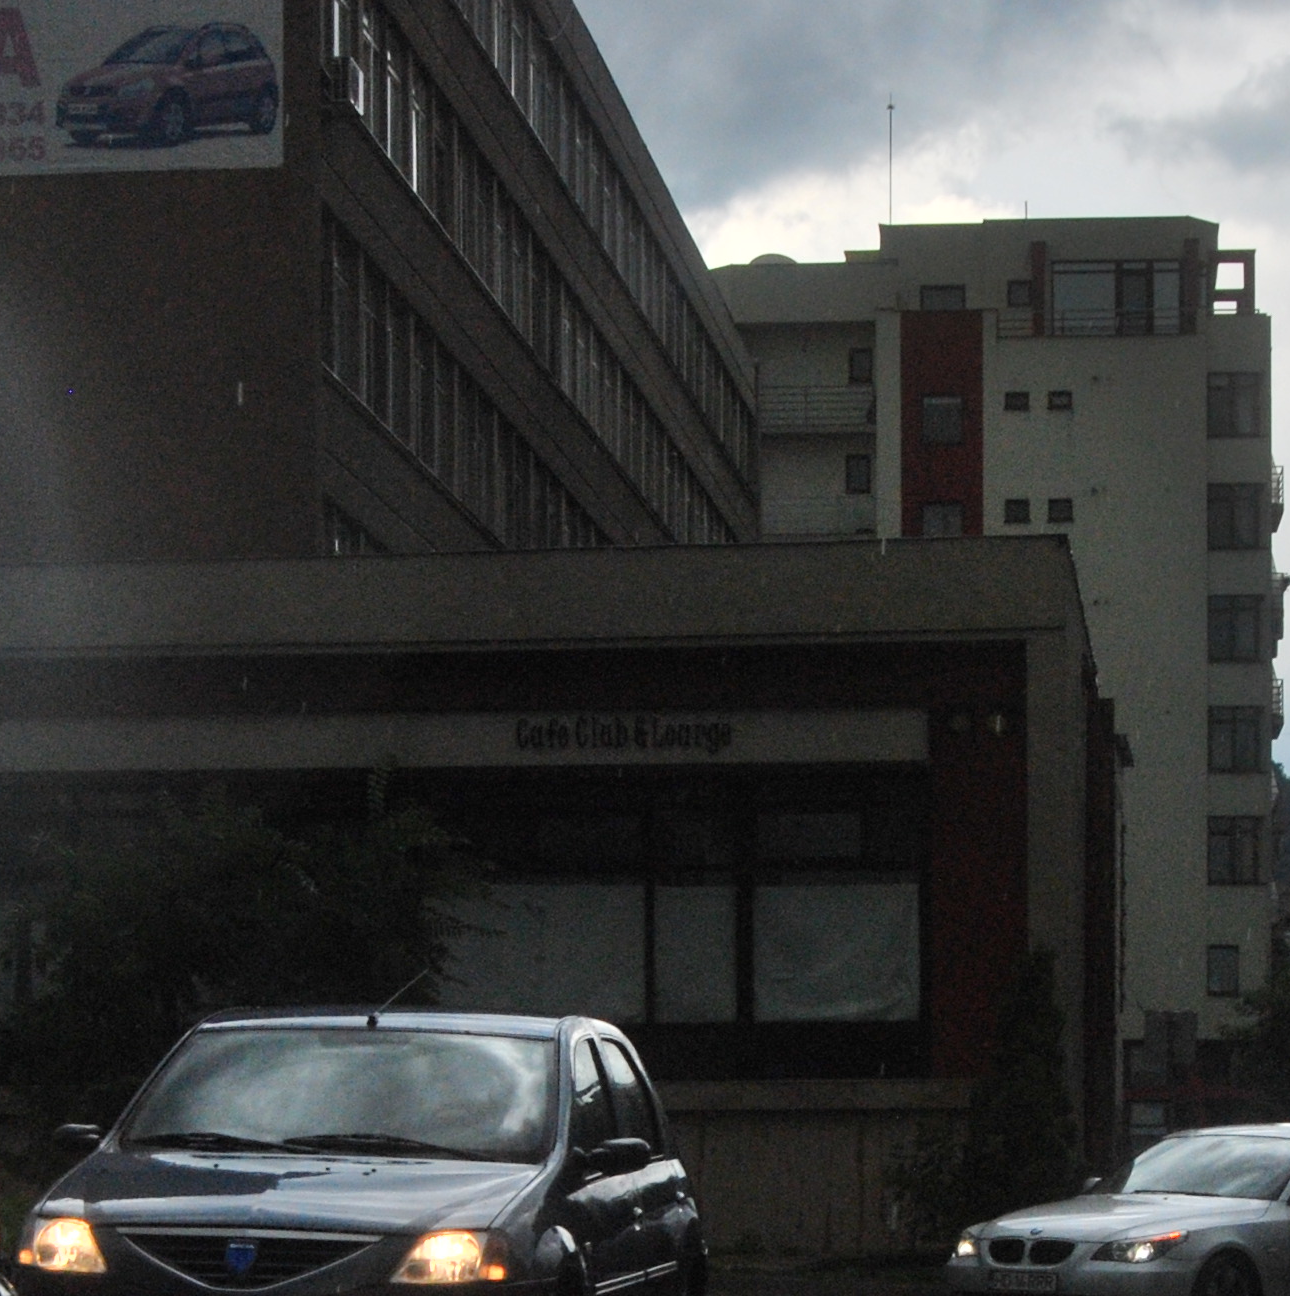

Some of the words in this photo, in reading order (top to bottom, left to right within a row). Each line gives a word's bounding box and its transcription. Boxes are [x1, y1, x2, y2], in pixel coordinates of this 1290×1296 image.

[515, 717, 571, 751] Cafe
[575, 715, 630, 749] Club
[651, 715, 733, 756] Lounge
